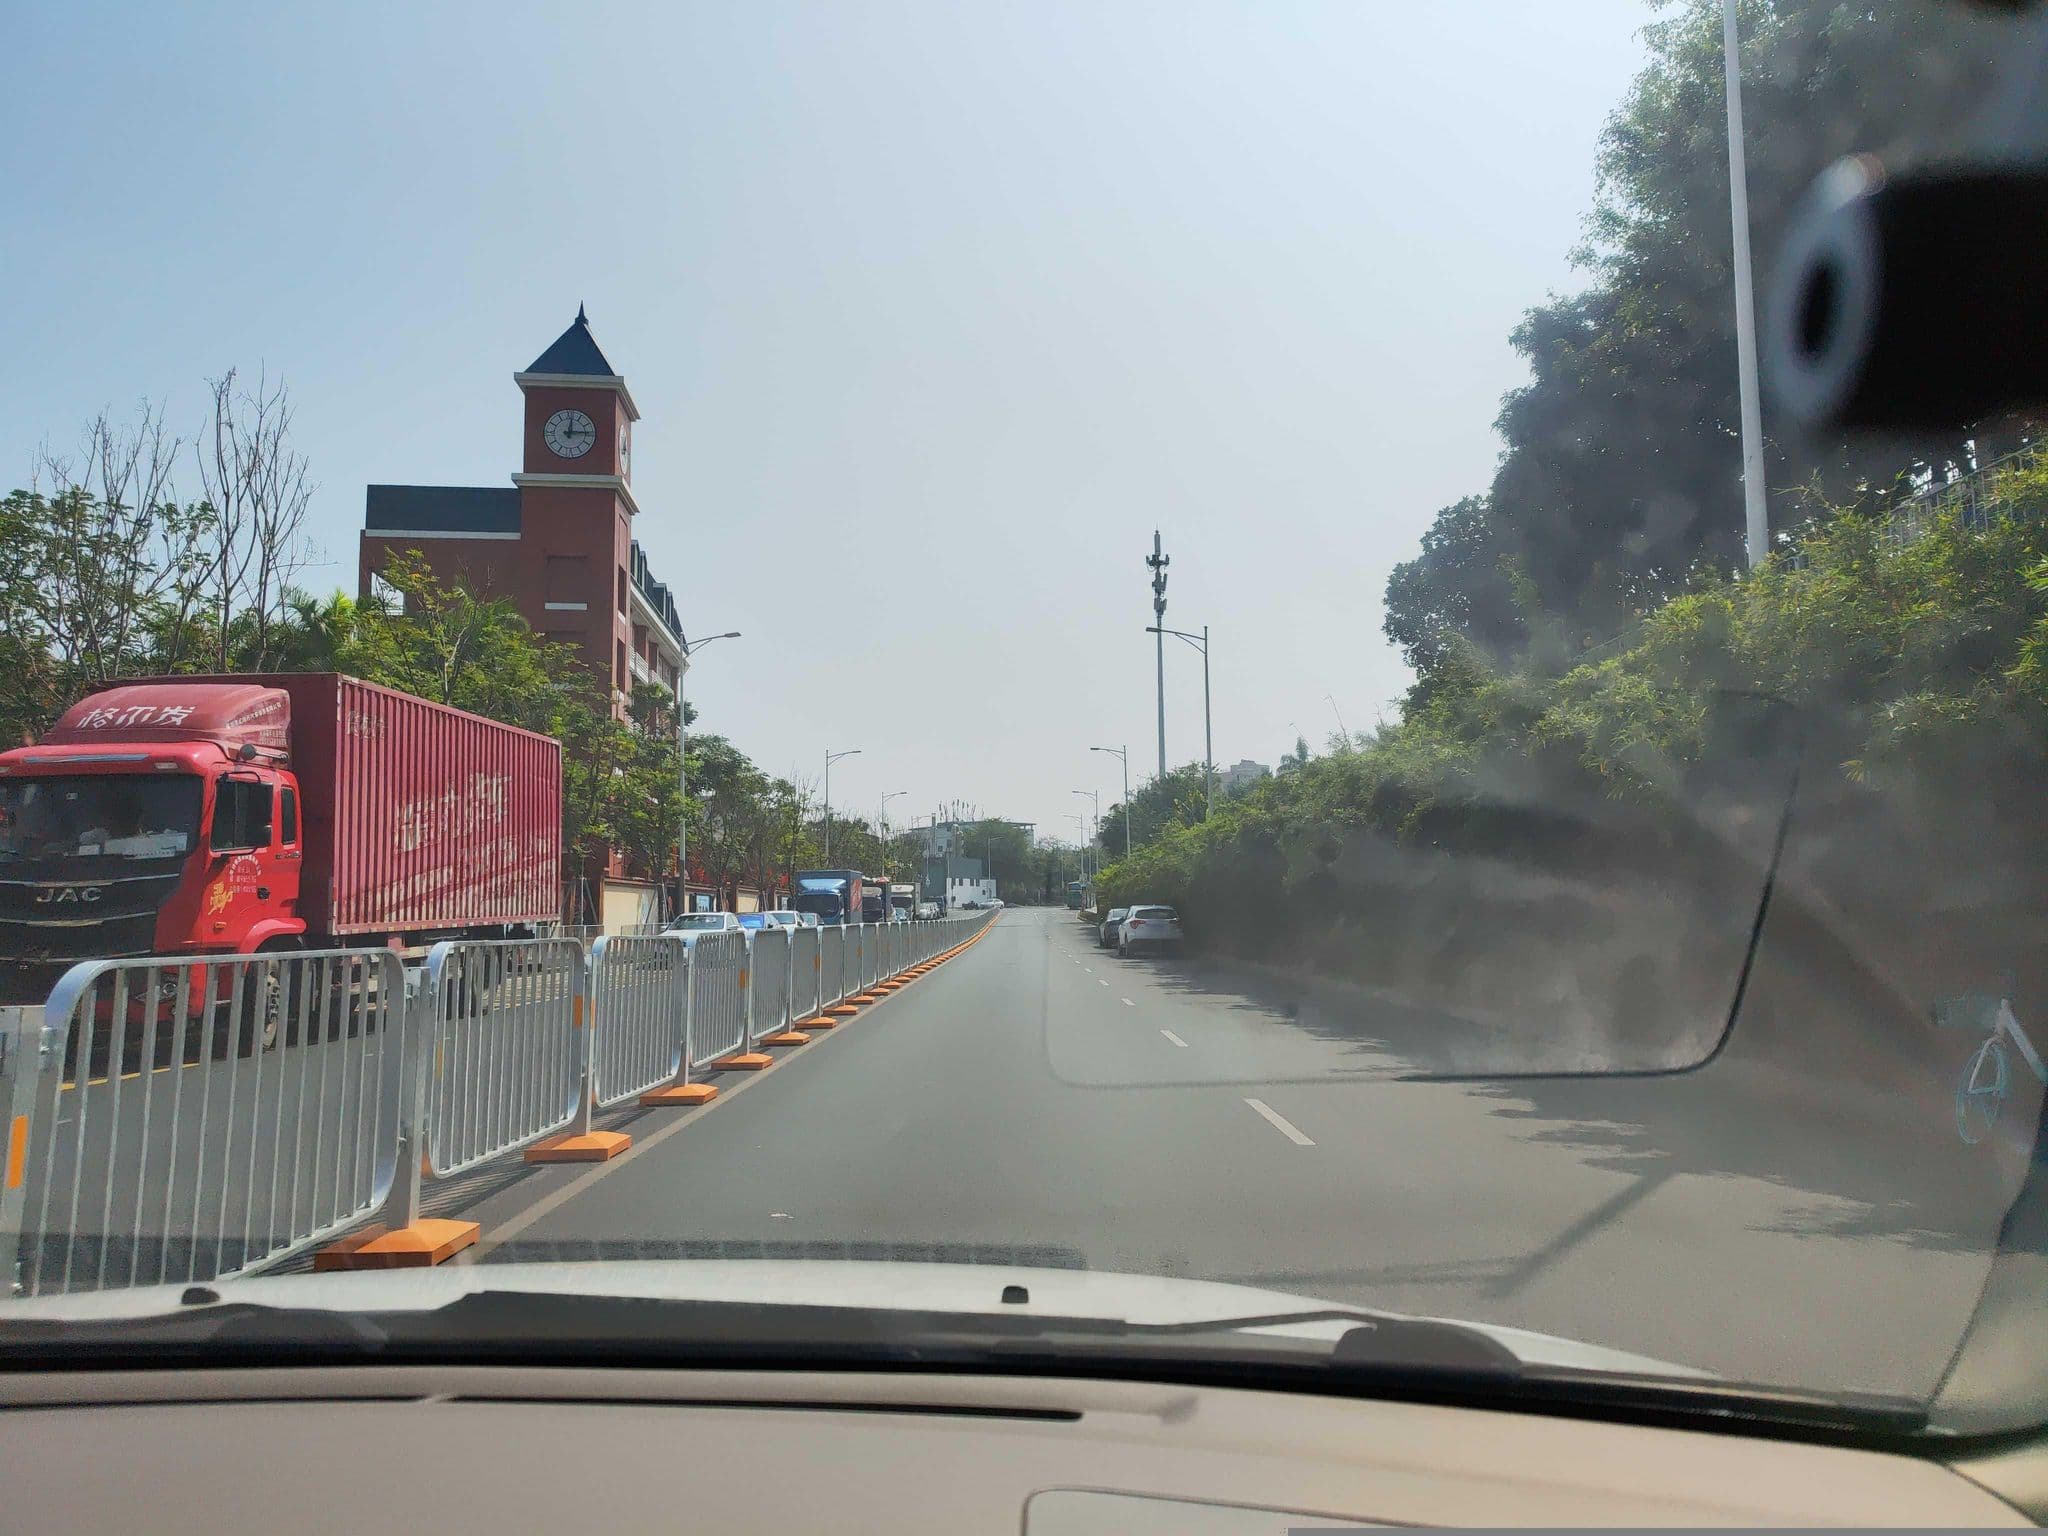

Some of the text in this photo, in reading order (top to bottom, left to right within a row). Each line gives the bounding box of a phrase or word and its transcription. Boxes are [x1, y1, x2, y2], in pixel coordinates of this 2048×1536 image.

[76, 705, 196, 729] 格尔发
[36, 887, 102, 903] JAC
